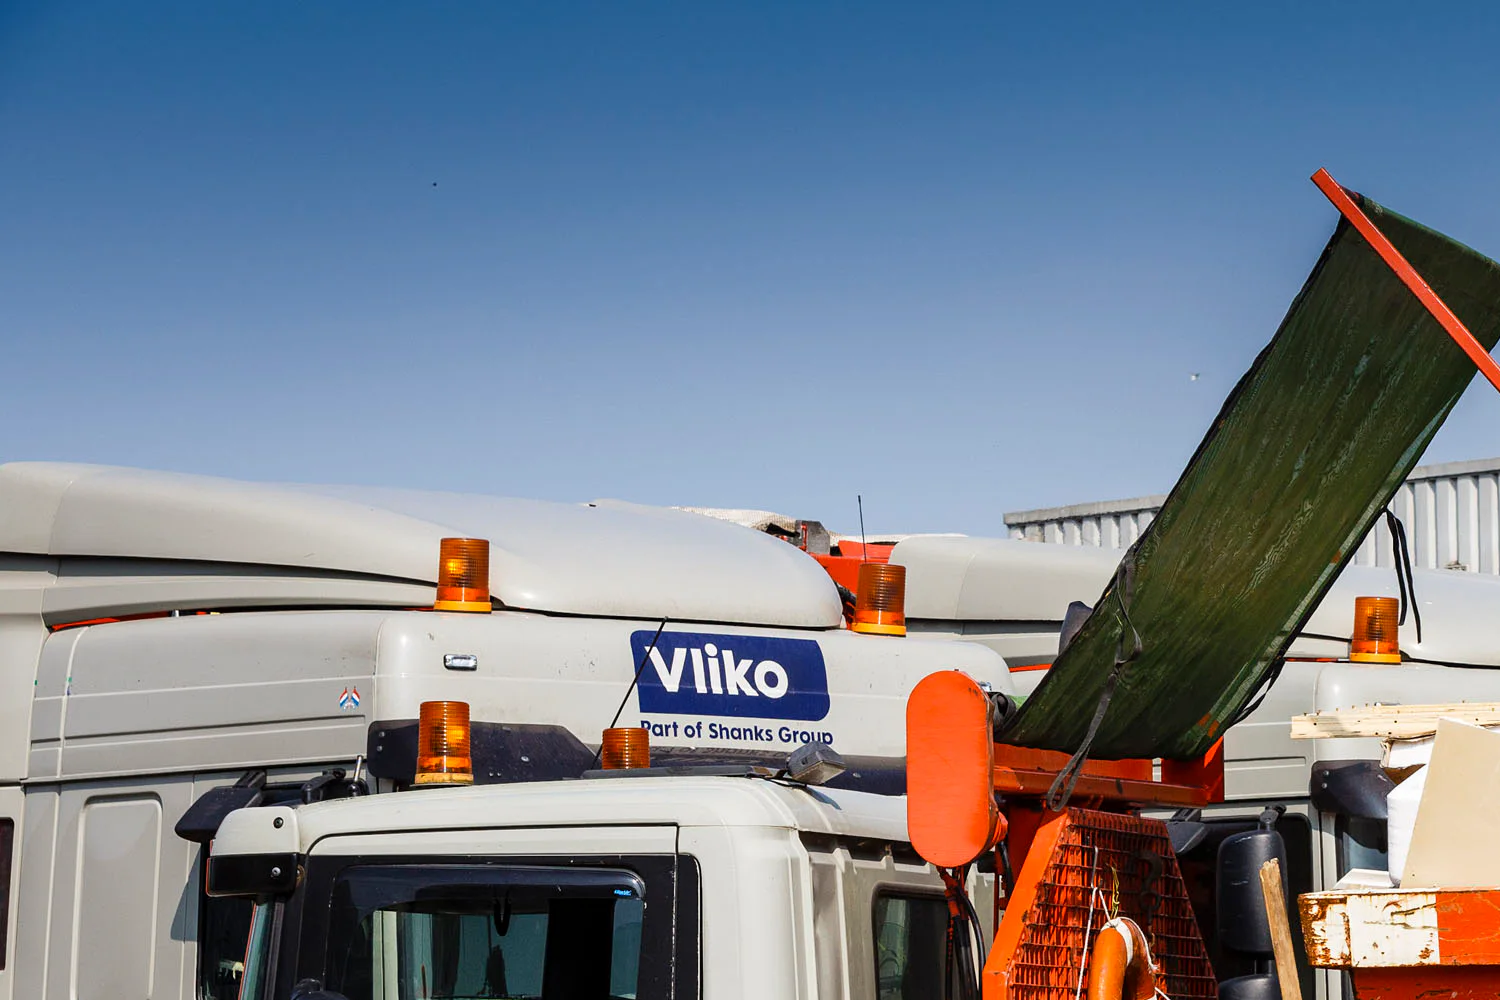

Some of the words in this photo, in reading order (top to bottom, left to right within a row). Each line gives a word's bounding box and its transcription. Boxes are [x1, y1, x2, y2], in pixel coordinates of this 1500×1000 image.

[644, 643, 789, 699] Vliko
[640, 720, 678, 738] Part
[684, 721, 703, 738] of
[709, 723, 773, 742] Shanks
[779, 726, 834, 745] Group
